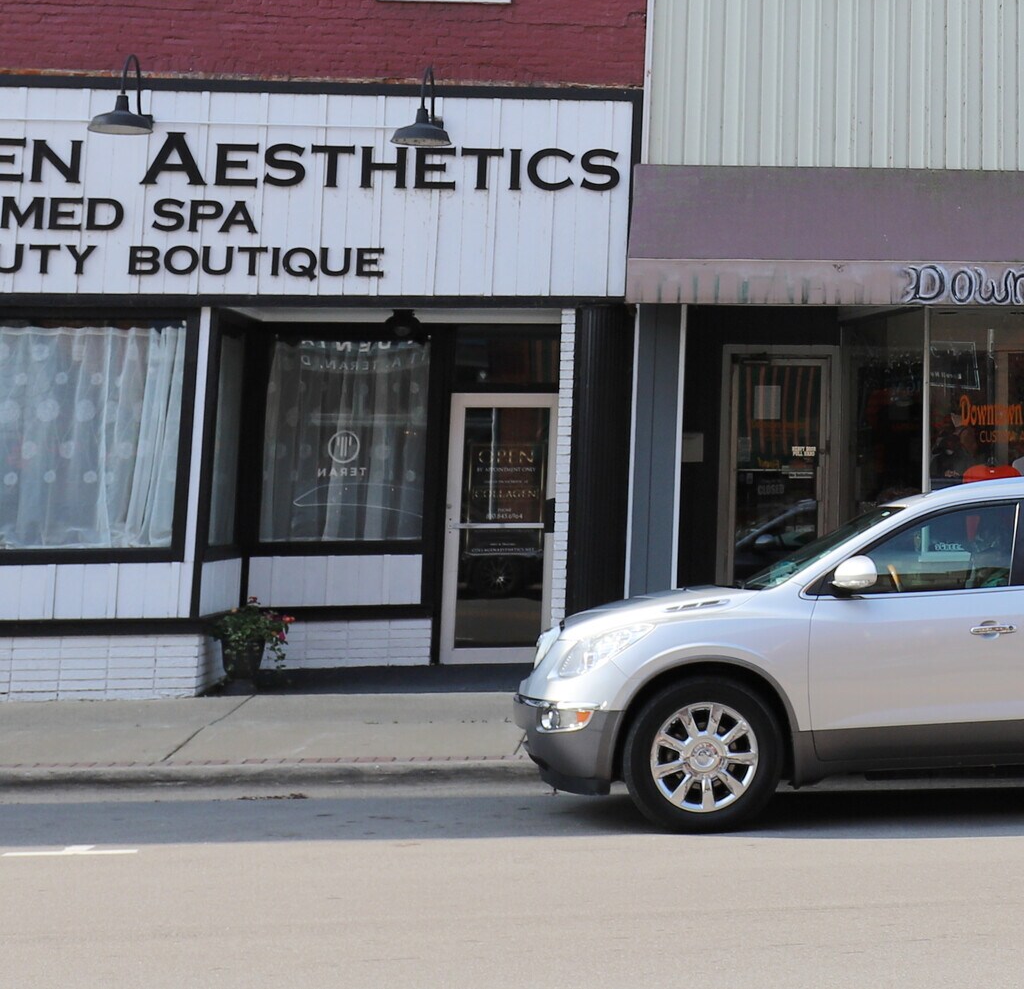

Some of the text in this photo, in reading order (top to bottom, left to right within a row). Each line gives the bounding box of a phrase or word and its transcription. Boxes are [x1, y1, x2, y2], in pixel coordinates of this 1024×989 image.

[139, 131, 621, 191] AESTHETICS
[0, 196, 258, 234] MED SPA
[127, 245, 385, 282] BOUTIQUE
[959, 394, 1023, 426] Downwn
[478, 449, 534, 463] OPEN
